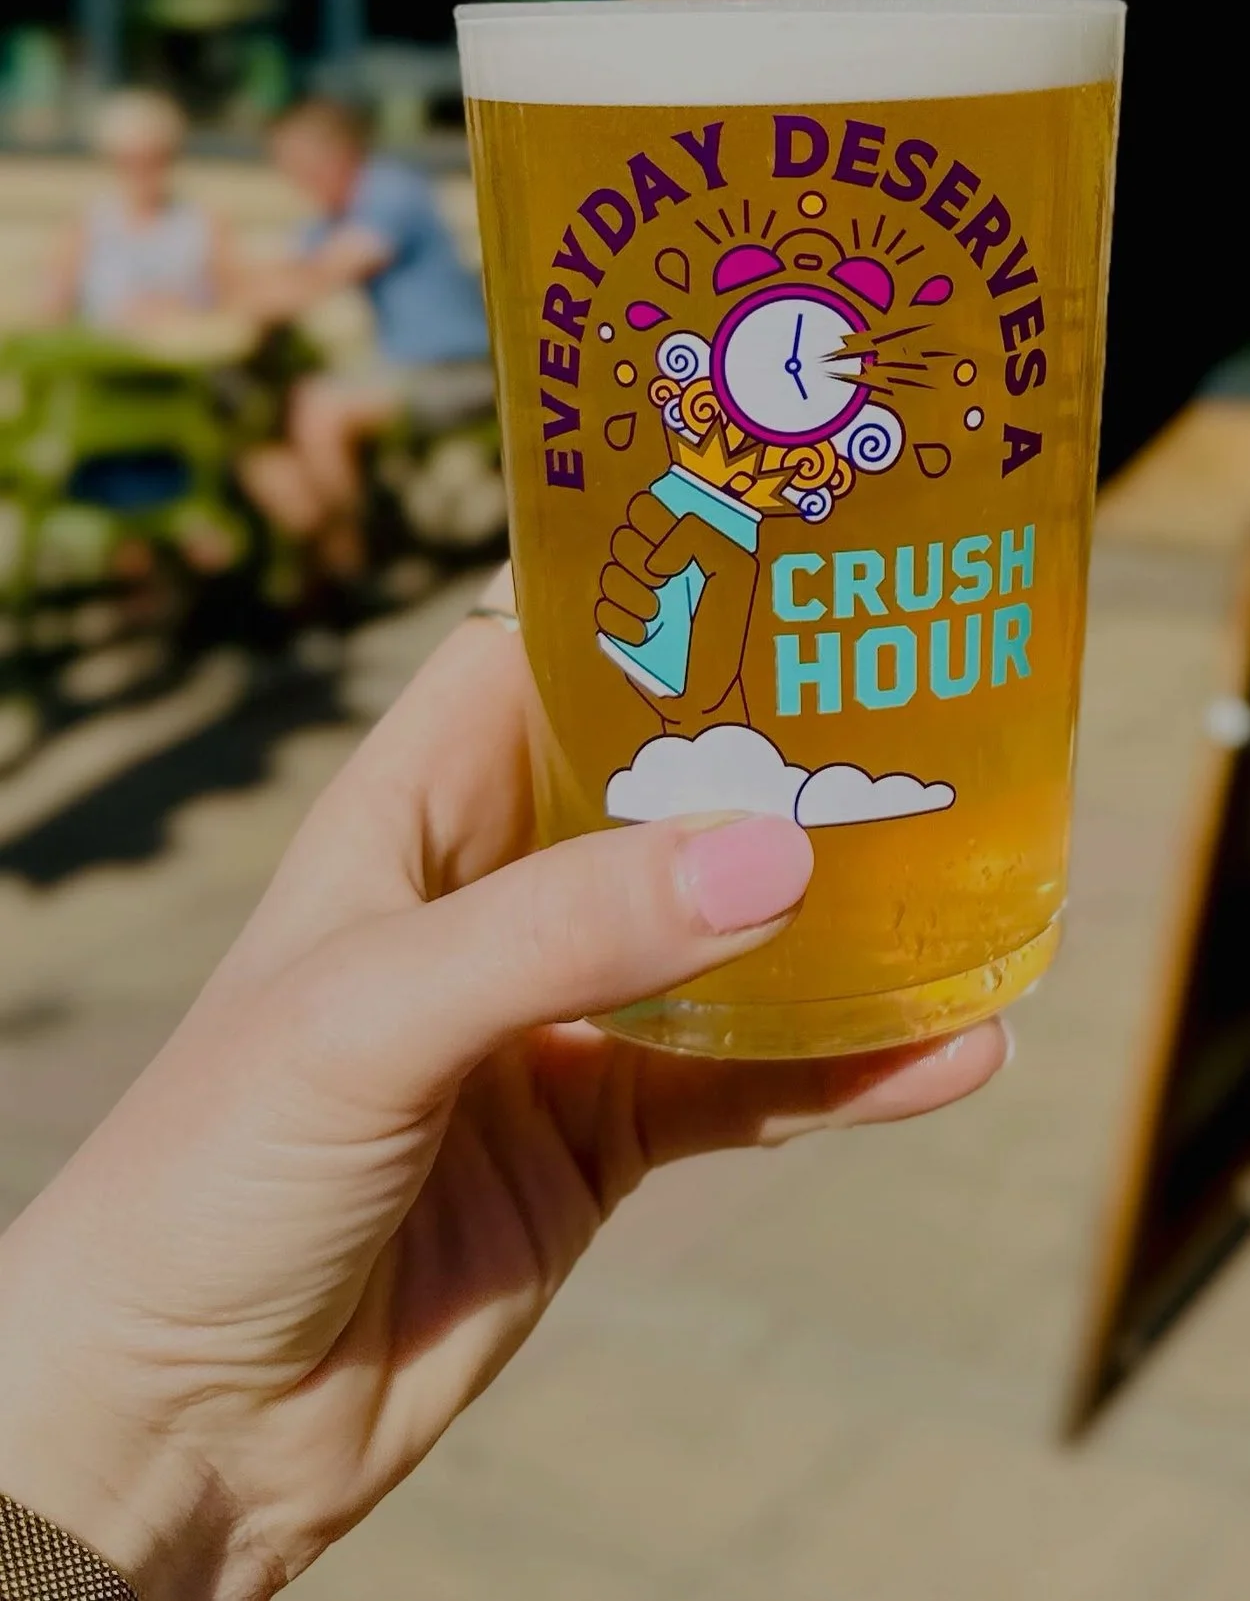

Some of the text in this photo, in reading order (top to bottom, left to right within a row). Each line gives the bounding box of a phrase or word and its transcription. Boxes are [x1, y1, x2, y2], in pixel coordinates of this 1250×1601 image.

[540, 114, 1047, 492] EVERYDAY DESERVES A
[771, 523, 1036, 623] CRUSH
[774, 603, 1032, 716] HOUR
